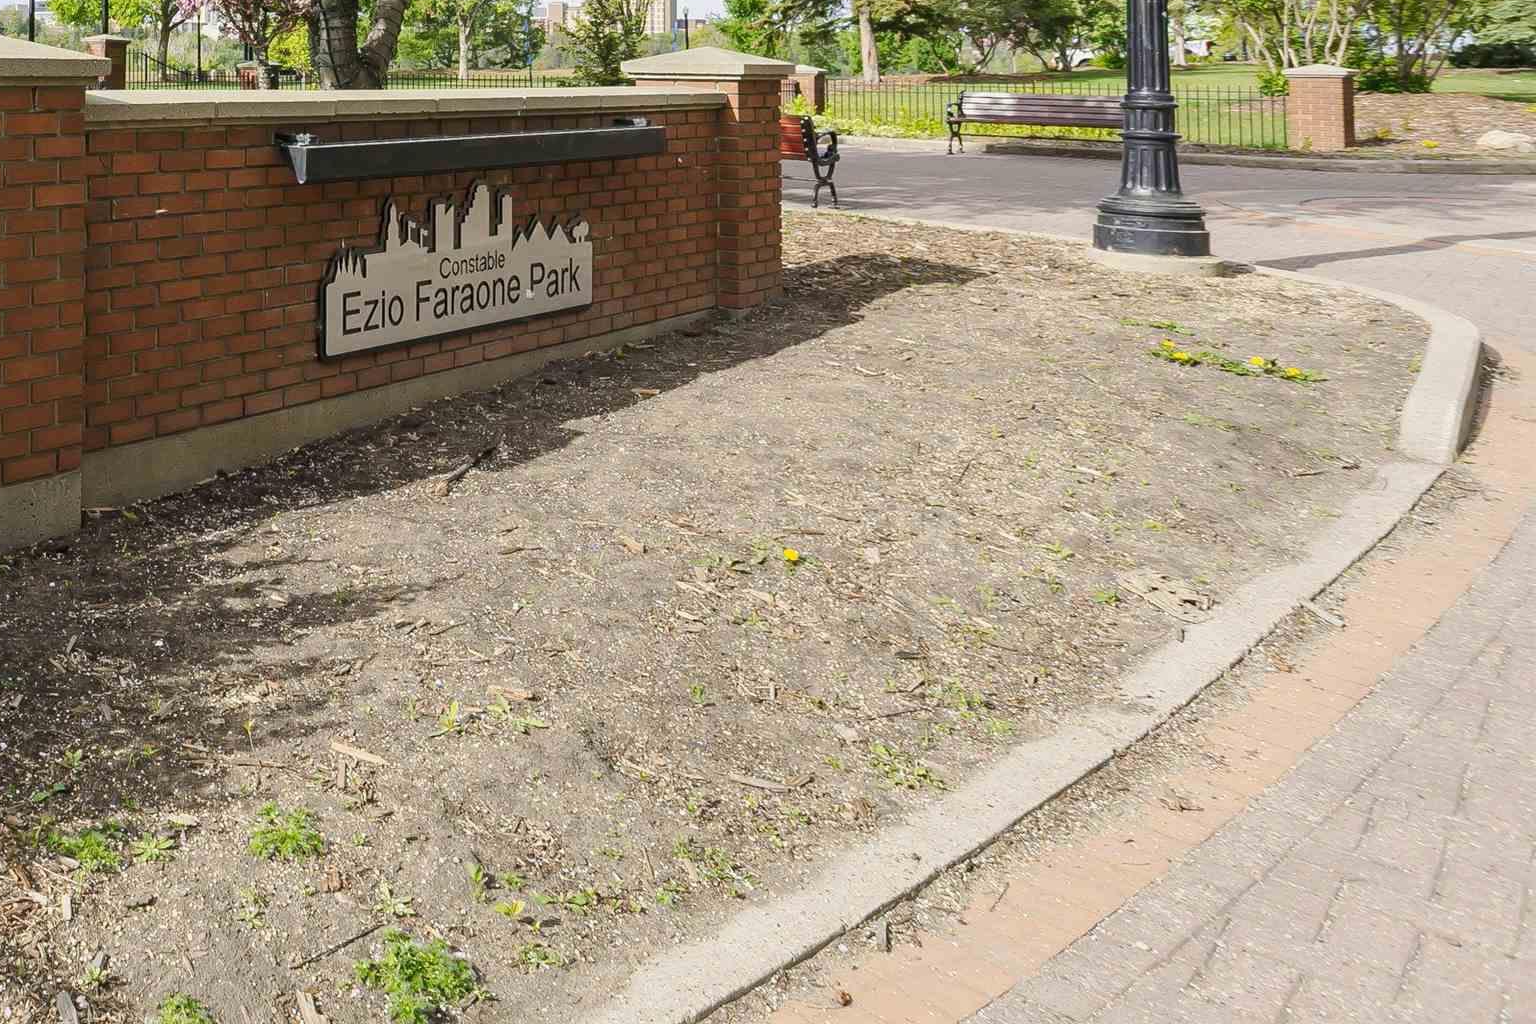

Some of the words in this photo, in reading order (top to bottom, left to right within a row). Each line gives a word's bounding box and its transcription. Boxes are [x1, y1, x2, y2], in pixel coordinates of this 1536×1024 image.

[439, 250, 506, 279] Constable
[342, 290, 404, 336] Ezio
[415, 274, 520, 322] Faraone
[529, 257, 581, 299] Park
